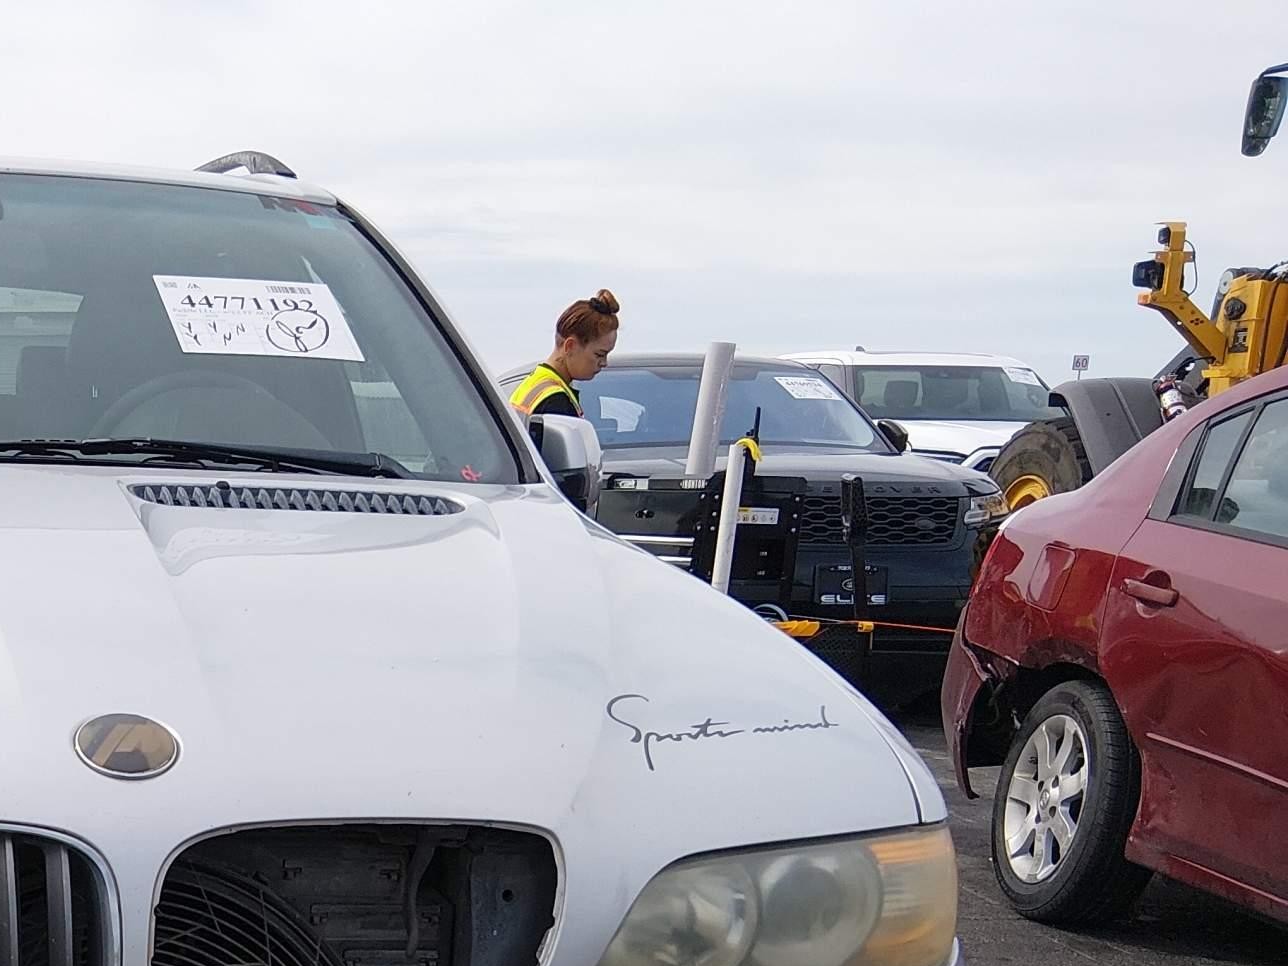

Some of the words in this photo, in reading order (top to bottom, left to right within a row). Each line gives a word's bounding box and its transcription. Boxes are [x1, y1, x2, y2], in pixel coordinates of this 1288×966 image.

[180, 294, 318, 314] 44771192
[1075, 358, 1088, 368] 60
[872, 485, 943, 495] OVER
[820, 593, 886, 605] ELIE
